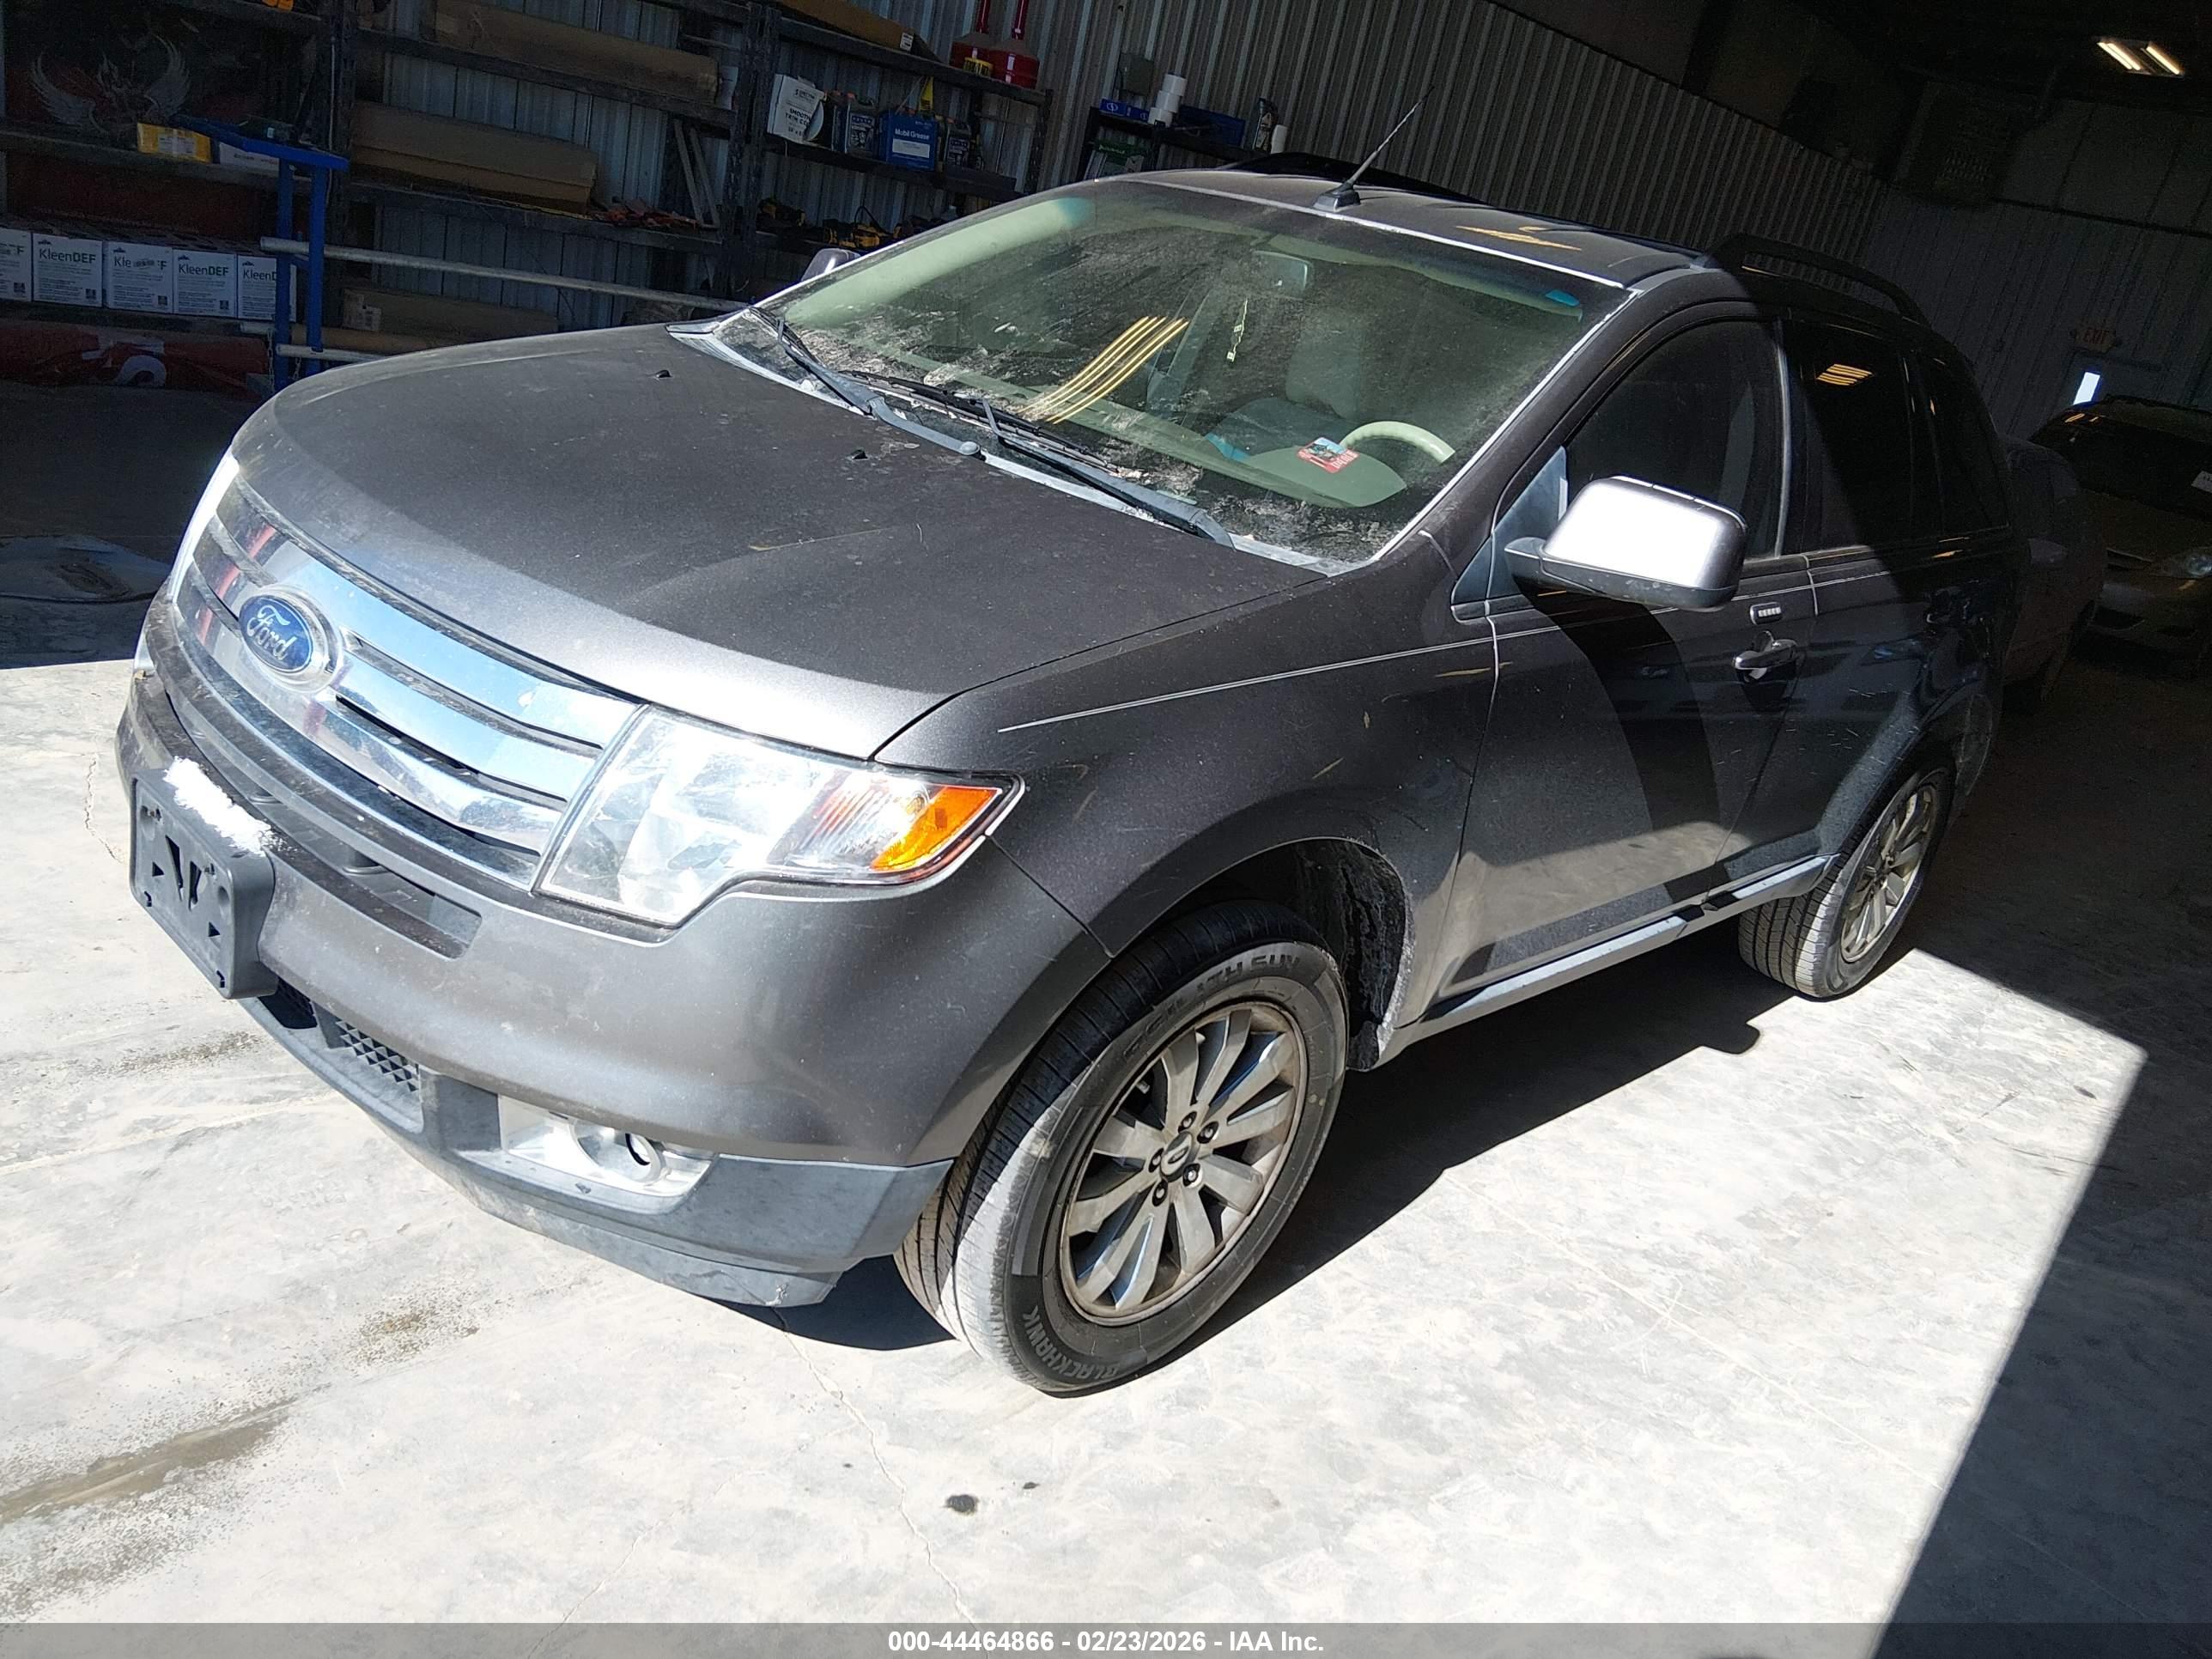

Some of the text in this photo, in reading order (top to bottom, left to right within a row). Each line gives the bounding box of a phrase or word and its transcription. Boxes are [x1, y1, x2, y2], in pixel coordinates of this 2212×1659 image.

[895, 126, 930, 140] Mobil Grease
[40, 247, 96, 264] KleenDEF
[178, 264, 228, 276] KleenDEF
[243, 269, 277, 282] KleenD
[2083, 329, 2108, 344] EXIT
[247, 605, 297, 660] Ford
[1251, 953, 1300, 969] SUV
[1023, 1304, 1121, 1379] BLACKHAWK
